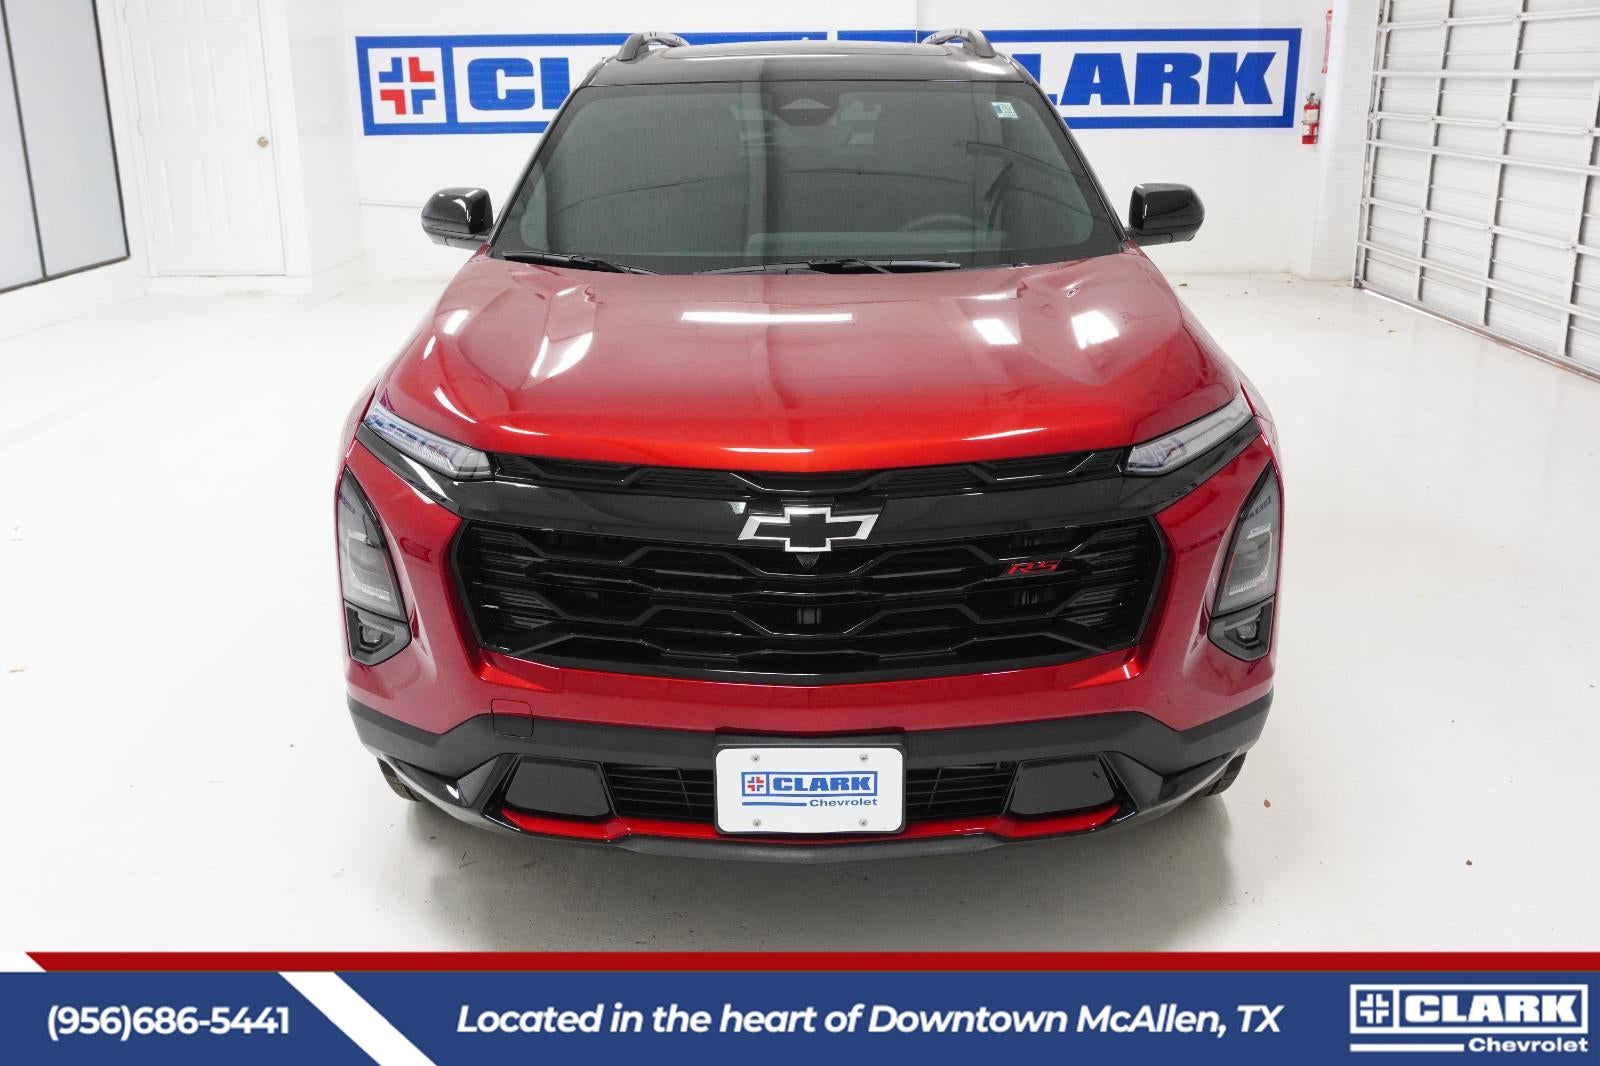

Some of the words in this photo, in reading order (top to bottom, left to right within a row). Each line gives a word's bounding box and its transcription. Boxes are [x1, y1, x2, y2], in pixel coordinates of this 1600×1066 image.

[1007, 560, 1059, 575] RS
[772, 776, 871, 792] CLARK
[809, 798, 878, 807] Chevrolet
